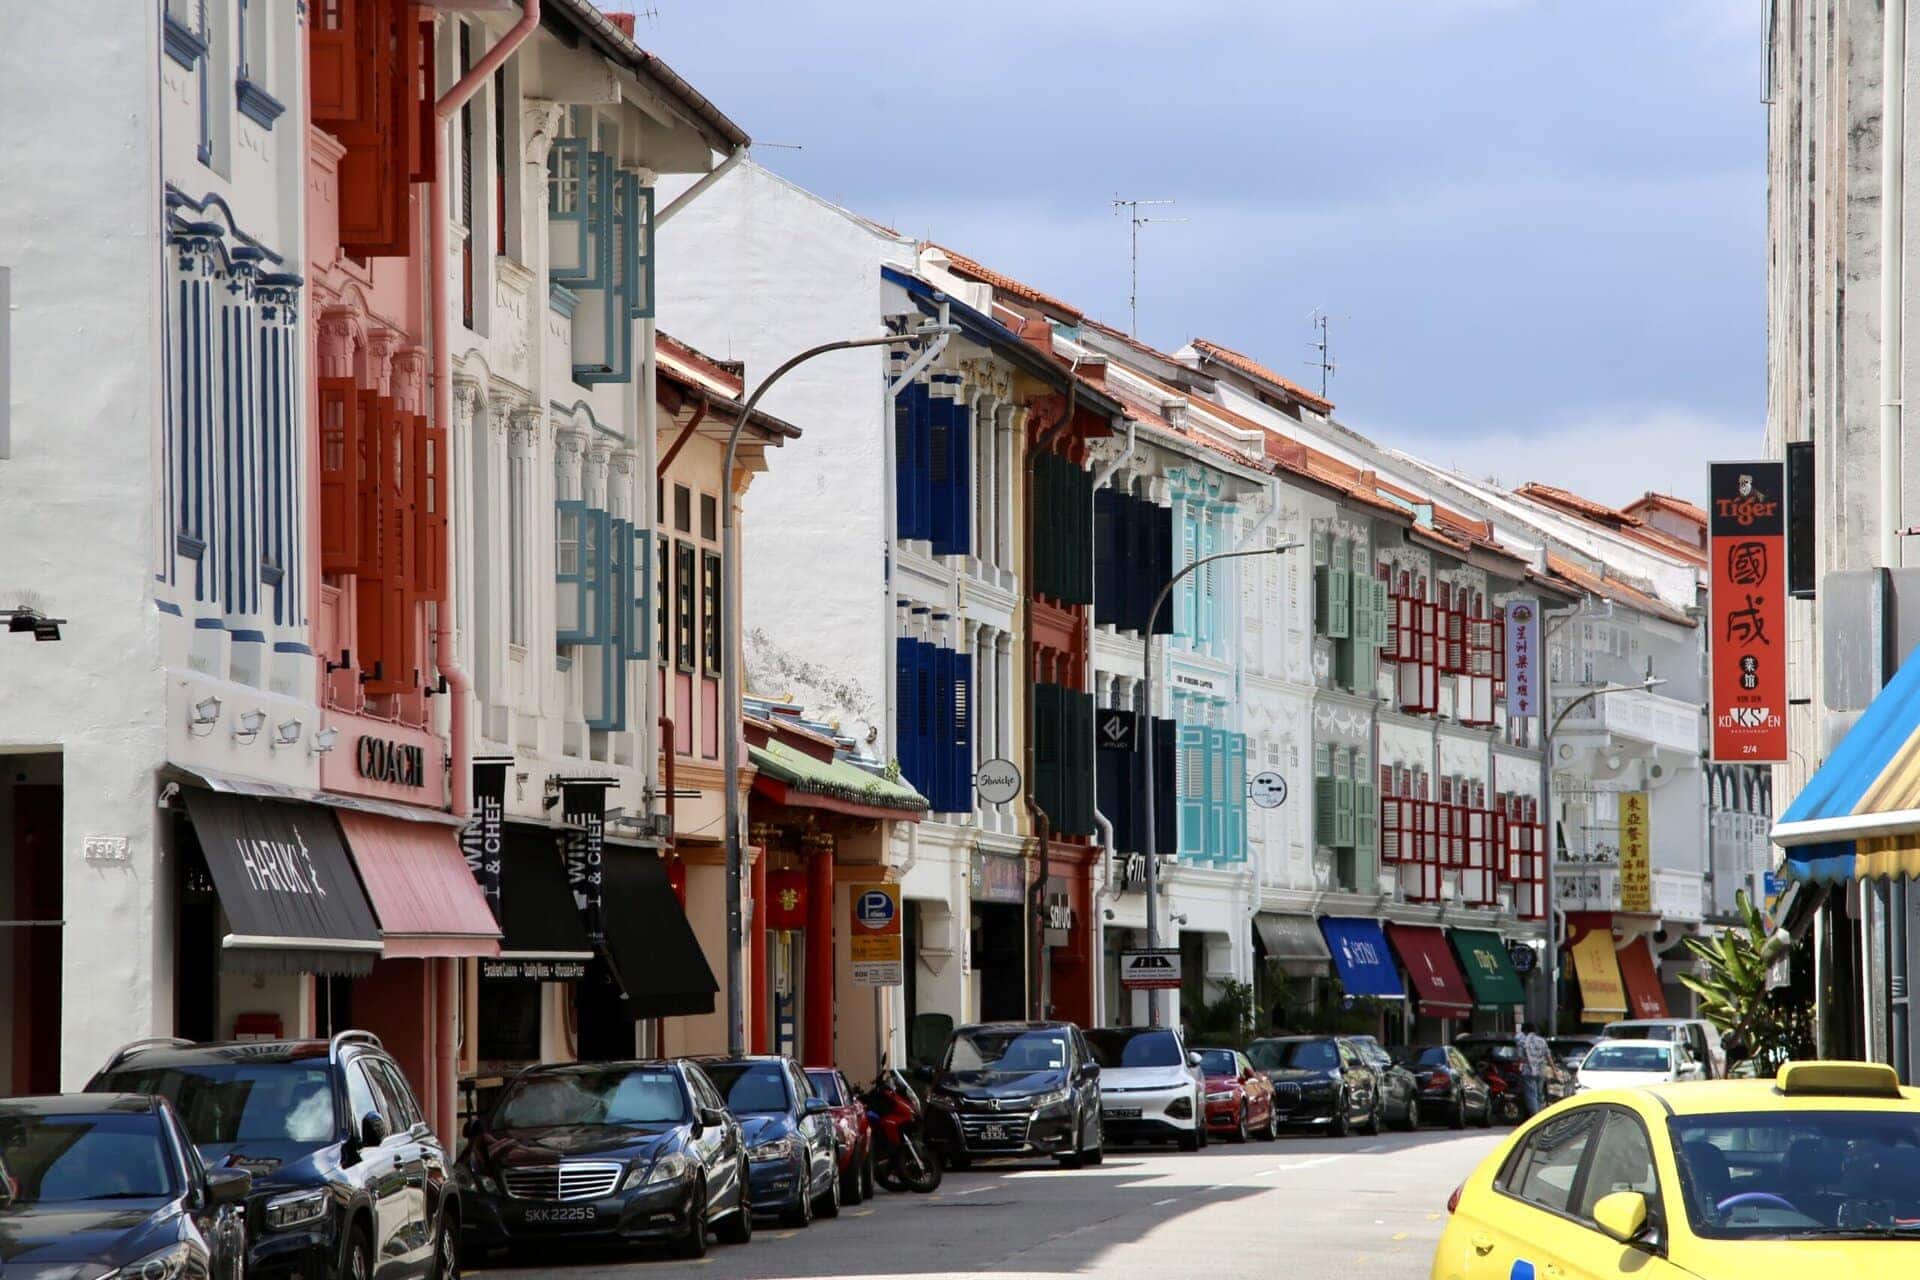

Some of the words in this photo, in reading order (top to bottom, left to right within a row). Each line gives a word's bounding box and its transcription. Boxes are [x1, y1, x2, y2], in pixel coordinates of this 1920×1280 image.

[1716, 496, 1777, 526] Tiger
[357, 735, 425, 787] COACH
[485, 796, 501, 853] CHEF
[568, 812, 586, 884] WINE
[588, 812, 601, 865] CHEF
[235, 838, 313, 894] HARUKI
[486, 860, 501, 874] &
[588, 871, 601, 884] &
[525, 1207, 595, 1221] SKK2225S
